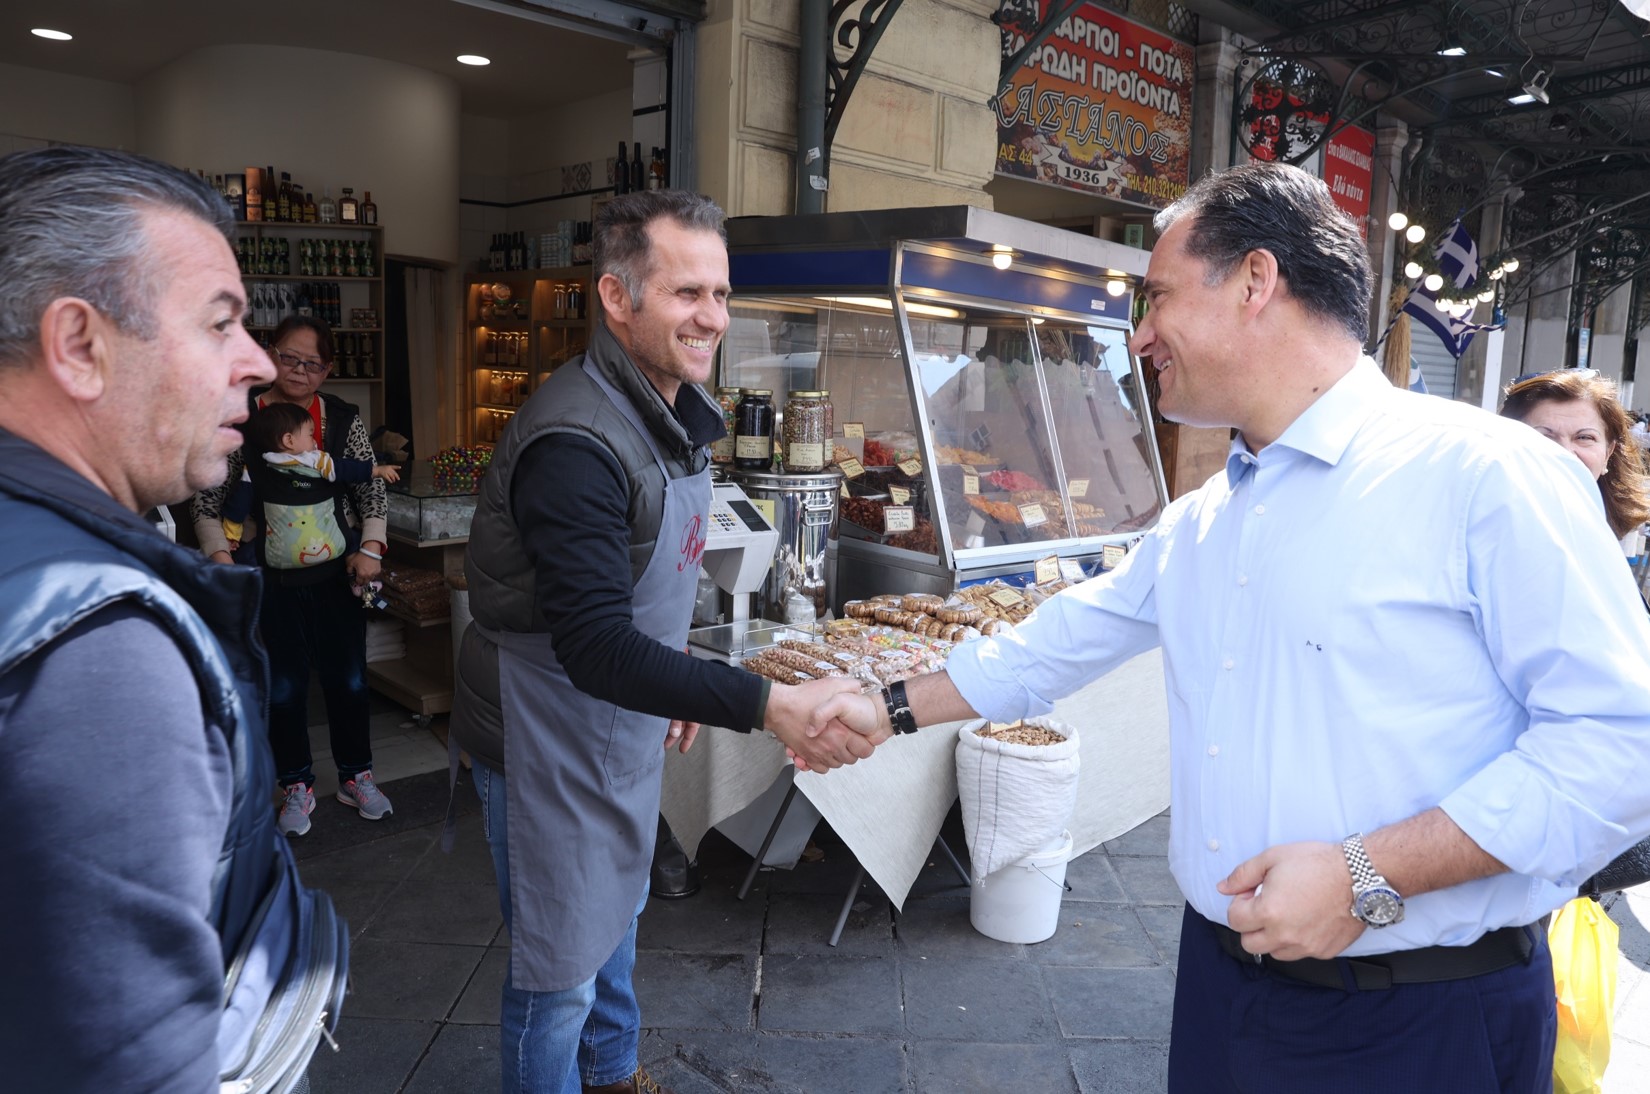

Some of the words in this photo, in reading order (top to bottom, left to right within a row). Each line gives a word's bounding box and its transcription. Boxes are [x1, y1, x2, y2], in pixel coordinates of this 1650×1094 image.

[1055, 15, 1119, 58] ΑΡΠΟΙ
[1139, 43, 1183, 83] ΠΟΤΑ
[1092, 62, 1180, 117] ΠΡΟΪΟΝΤΑ
[1019, 148, 1033, 165] 44
[1064, 166, 1100, 185] 1936
